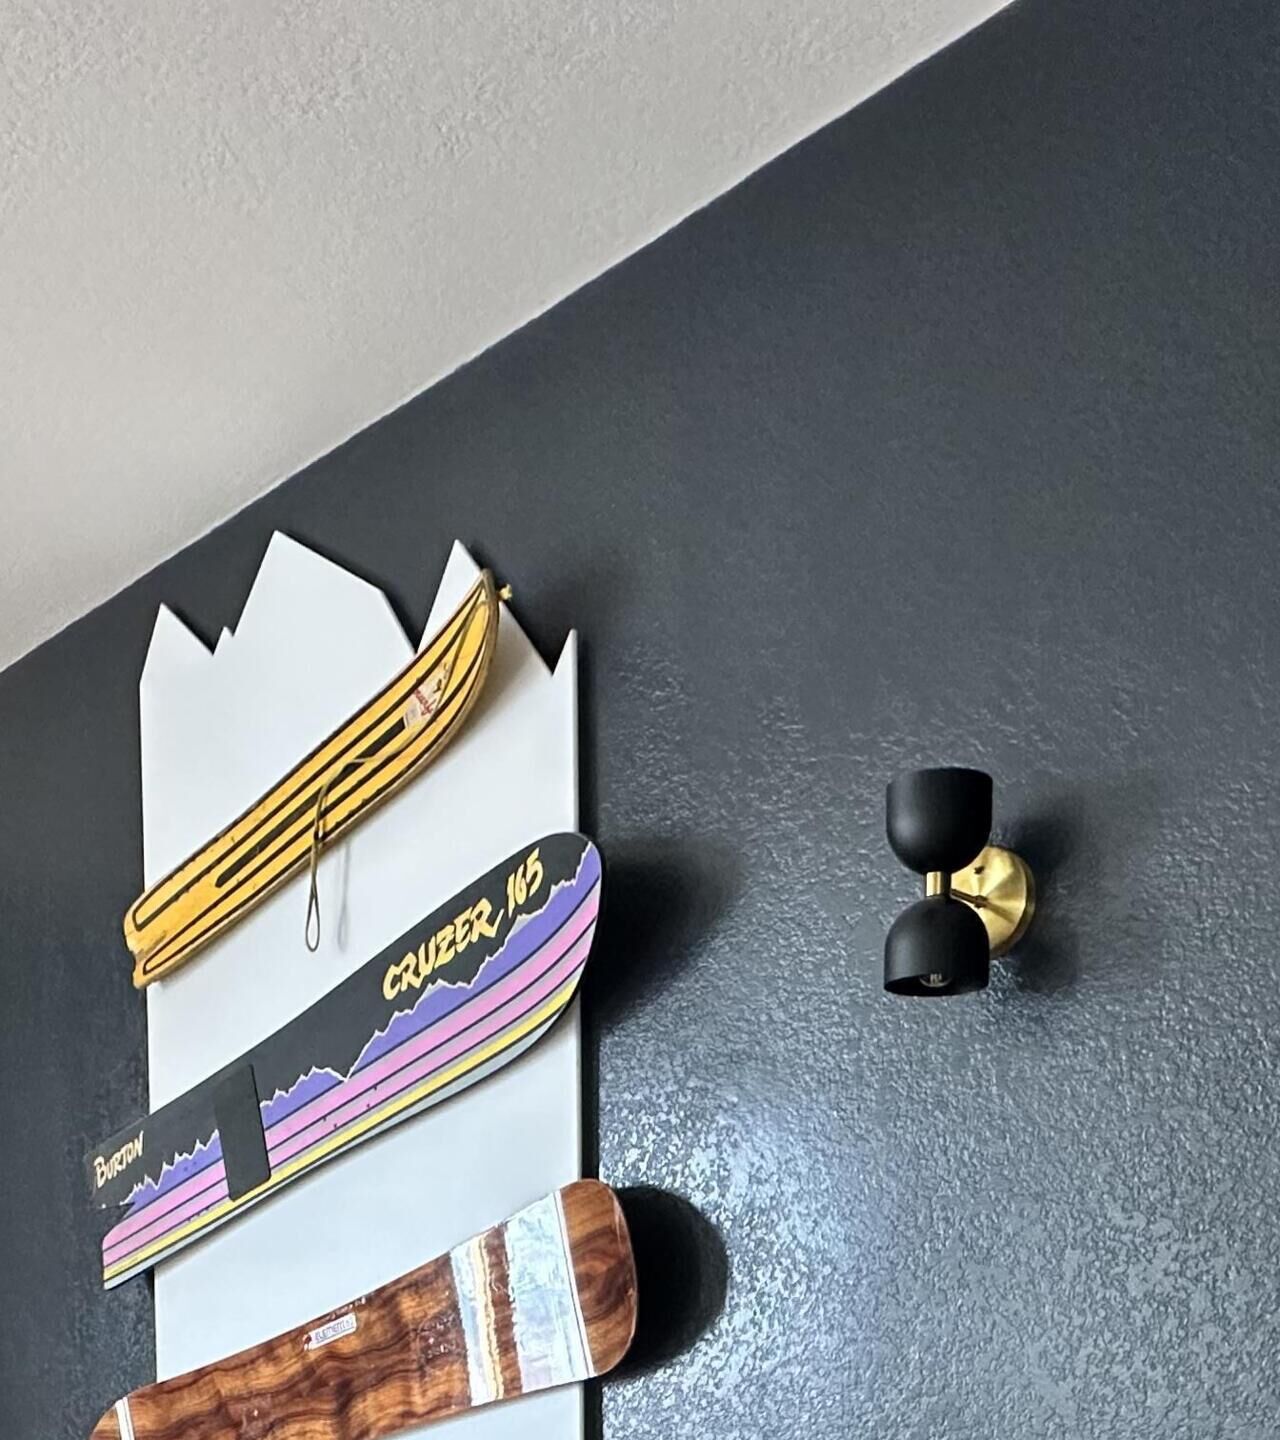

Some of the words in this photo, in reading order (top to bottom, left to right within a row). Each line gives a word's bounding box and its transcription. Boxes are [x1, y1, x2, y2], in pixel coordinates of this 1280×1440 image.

[383, 897, 504, 1000] CRUZER
[507, 847, 543, 918] 165
[94, 1130, 144, 1188] BURTON
